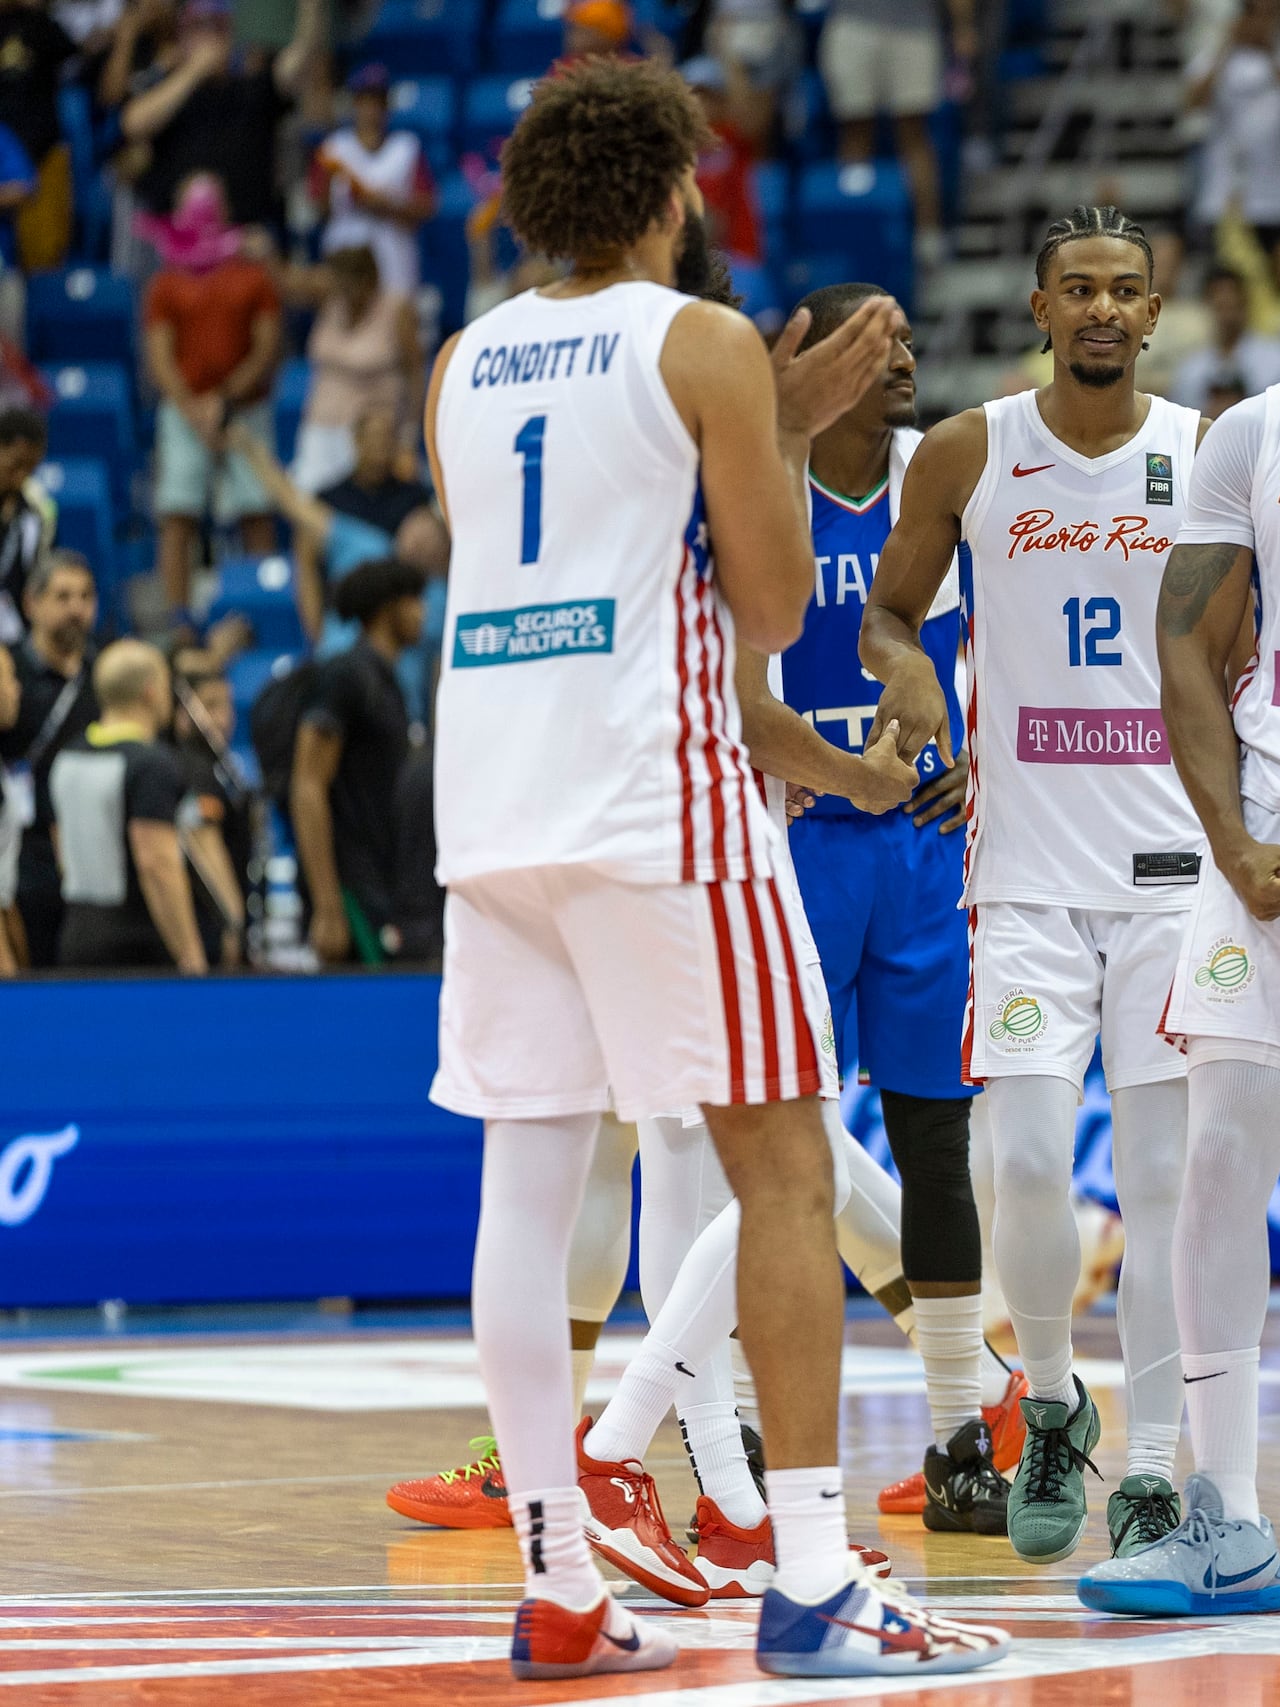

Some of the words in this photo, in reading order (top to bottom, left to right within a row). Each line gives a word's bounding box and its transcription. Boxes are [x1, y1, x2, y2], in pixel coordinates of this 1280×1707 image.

[472, 337, 584, 390] CONDITT
[586, 333, 621, 376] IV
[513, 415, 547, 566] 1
[1150, 481, 1169, 492] FIBA
[1007, 508, 1100, 560] Puerto
[1103, 514, 1174, 562] Rico
[514, 605, 598, 635] SEGUROS
[1062, 597, 1123, 667] 12
[1055, 719, 1162, 755] Mobile
[996, 988, 1025, 1016] LOTERÍA
[1018, 1030, 1044, 1045] PUERTO
[1041, 1013, 1049, 1031] RICO
